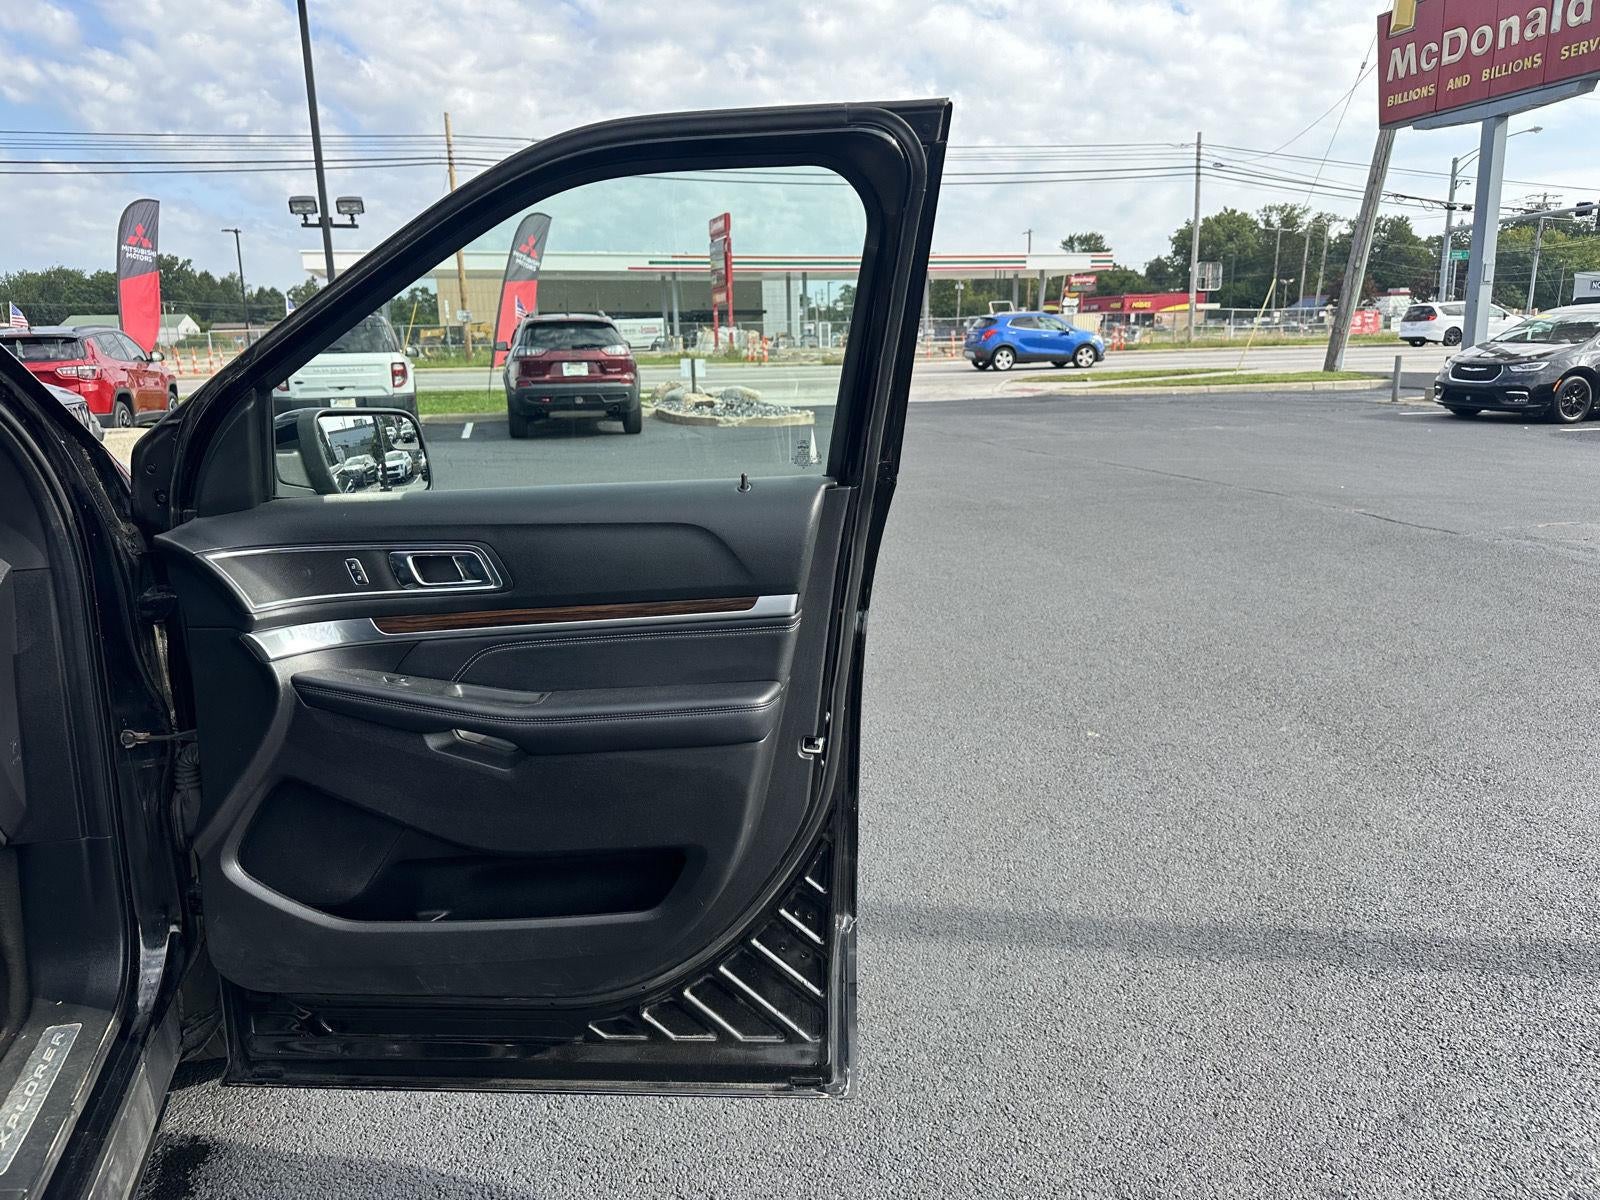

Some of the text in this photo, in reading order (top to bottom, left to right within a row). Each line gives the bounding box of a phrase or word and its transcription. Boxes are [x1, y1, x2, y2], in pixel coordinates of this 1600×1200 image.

[1387, 36, 1600, 108] BILLIONS AND BILLIONS SERV
[121, 245, 156, 257] MITSUBISHI
[126, 252, 153, 262] MOTORS
